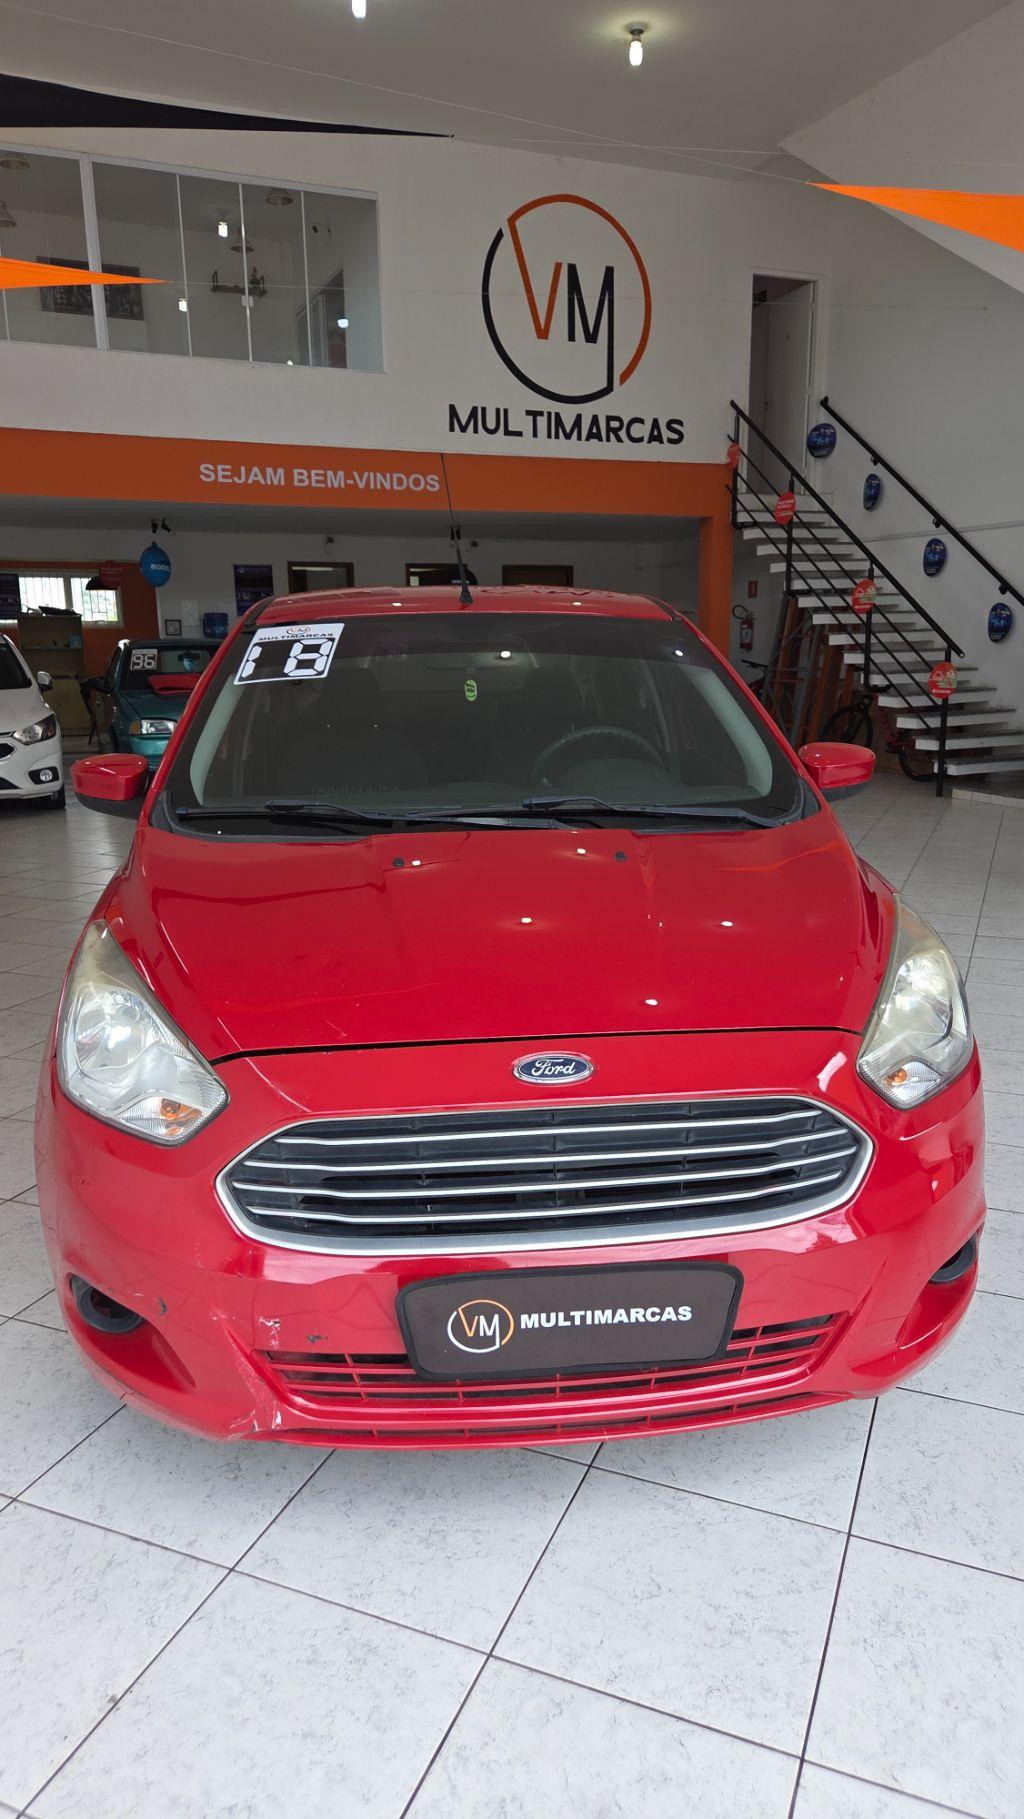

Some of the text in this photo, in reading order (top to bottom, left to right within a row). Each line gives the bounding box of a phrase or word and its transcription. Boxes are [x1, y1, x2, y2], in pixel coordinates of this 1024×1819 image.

[449, 404, 685, 445] MULTIMARCAS
[199, 463, 440, 492] SEJAM BEM-VINDOS
[258, 633, 334, 641] MULTIMARCAS
[133, 654, 156, 669] 96
[531, 1058, 576, 1076] Ford
[520, 1305, 693, 1329] MULTIMARCAS
